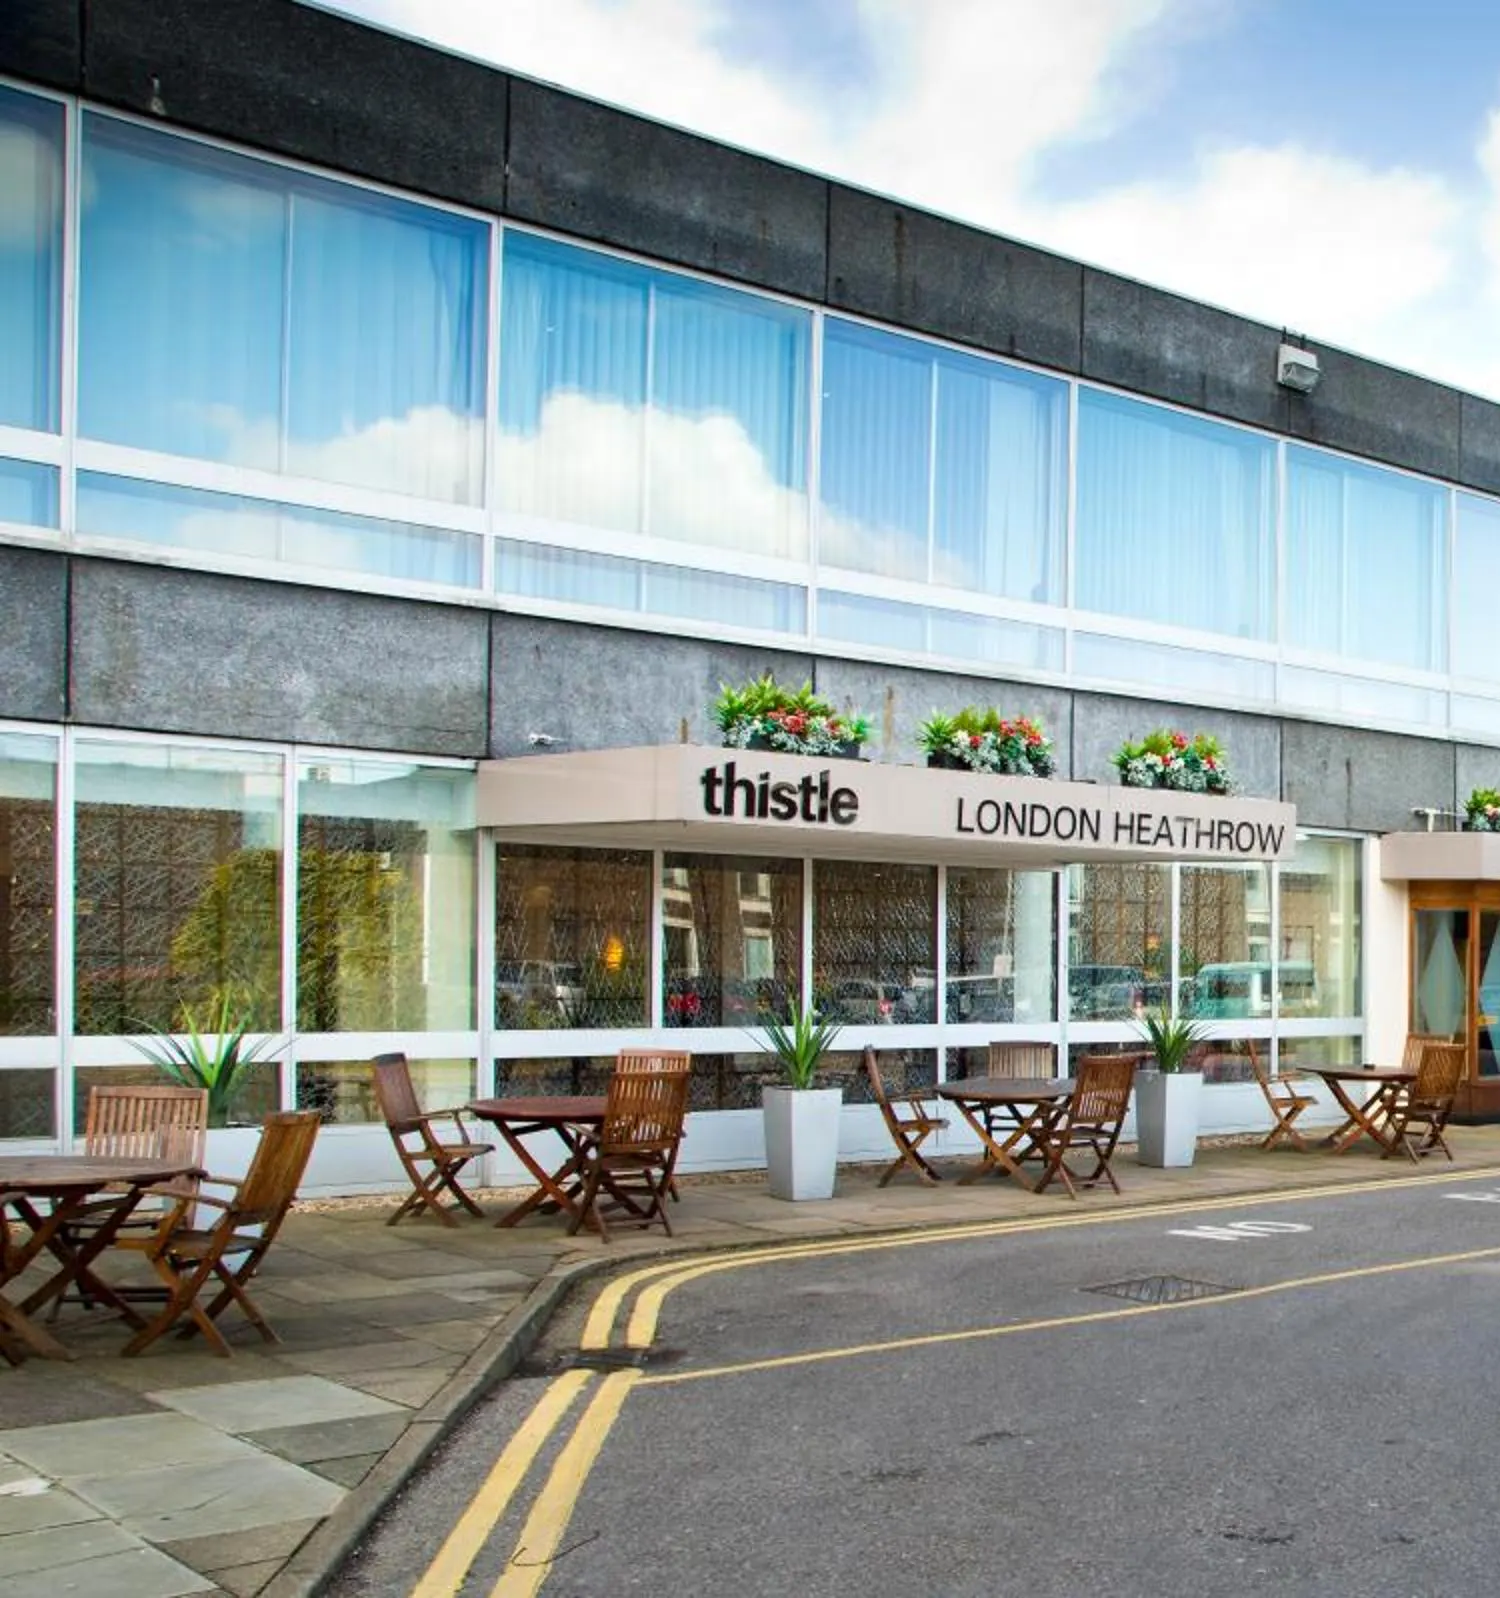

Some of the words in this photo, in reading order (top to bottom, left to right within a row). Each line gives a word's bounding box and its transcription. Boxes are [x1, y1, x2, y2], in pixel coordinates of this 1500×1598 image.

[700, 761, 859, 825] thistle
[956, 797, 1101, 842] LONDON
[1113, 811, 1285, 855] HEATHROW
[1166, 1221, 1313, 1241] NO
